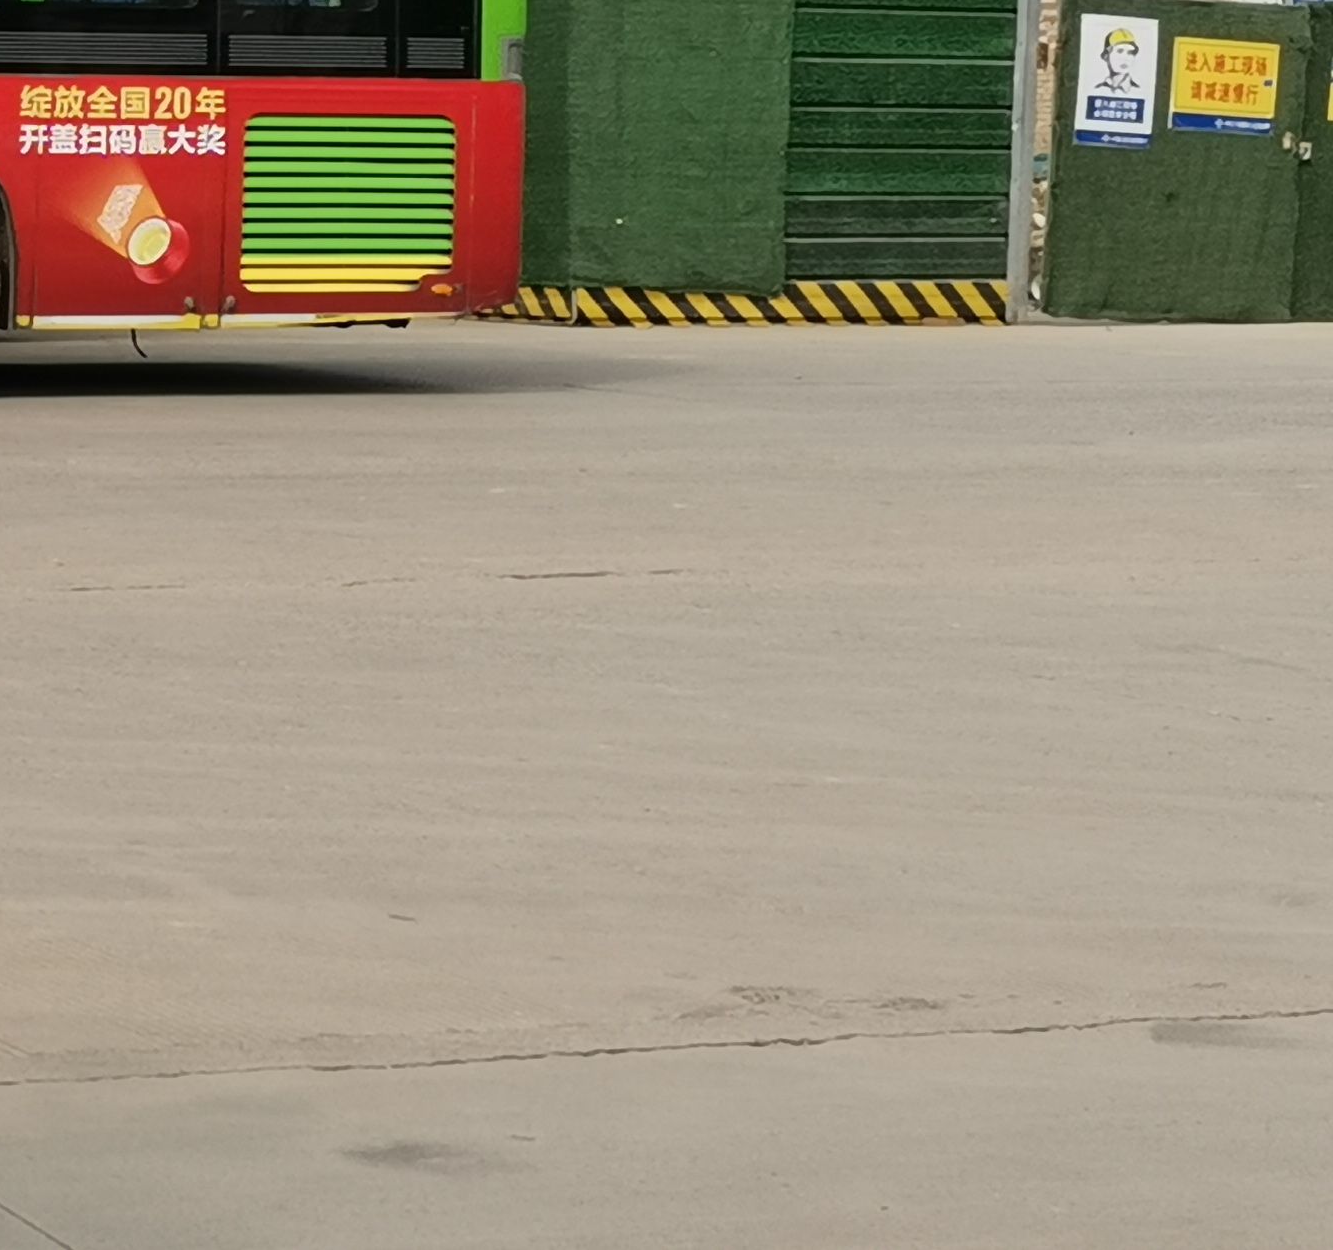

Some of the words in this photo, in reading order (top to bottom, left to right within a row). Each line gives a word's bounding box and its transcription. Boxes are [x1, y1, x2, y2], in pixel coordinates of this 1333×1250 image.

[1185, 51, 1268, 77] 进入施工现场
[20, 85, 227, 120] 绽放全国20年
[1191, 80, 1259, 105] 请减速慢行
[19, 124, 227, 155] 开盖扫码赢大奖
